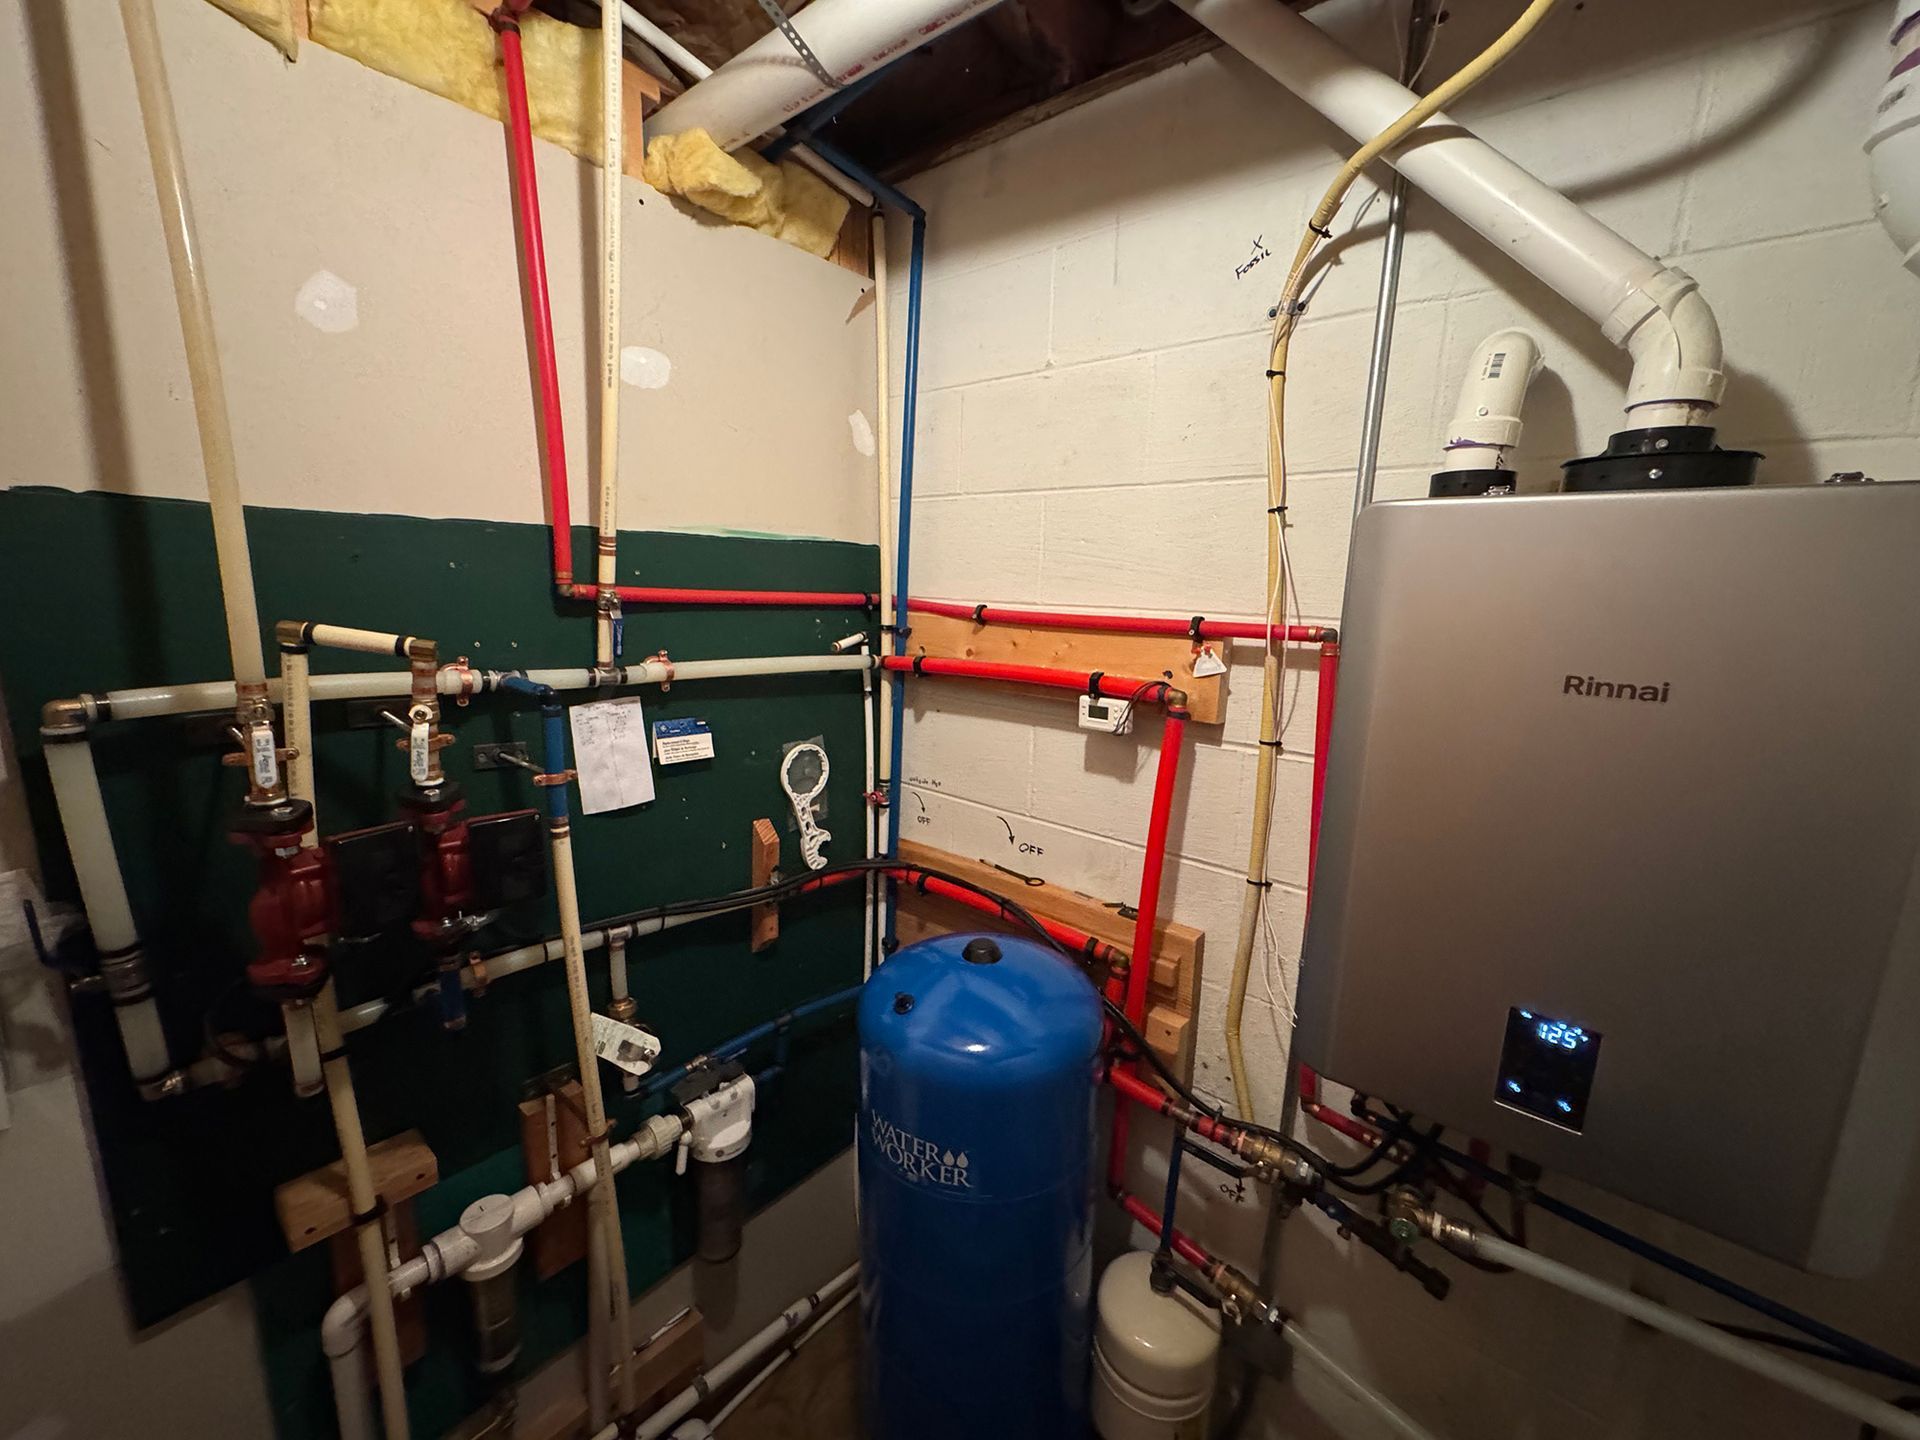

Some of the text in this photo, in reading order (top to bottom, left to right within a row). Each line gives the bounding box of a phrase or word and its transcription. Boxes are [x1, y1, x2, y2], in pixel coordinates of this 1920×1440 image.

[1562, 675, 1671, 703] Rinnai
[917, 815, 931, 826] OFF
[1018, 842, 1044, 856] OFF
[1538, 1022, 1577, 1049] 125
[872, 1109, 942, 1164] WATER
[872, 1127, 975, 1188] WORKER
[1220, 1184, 1244, 1203] OFF
